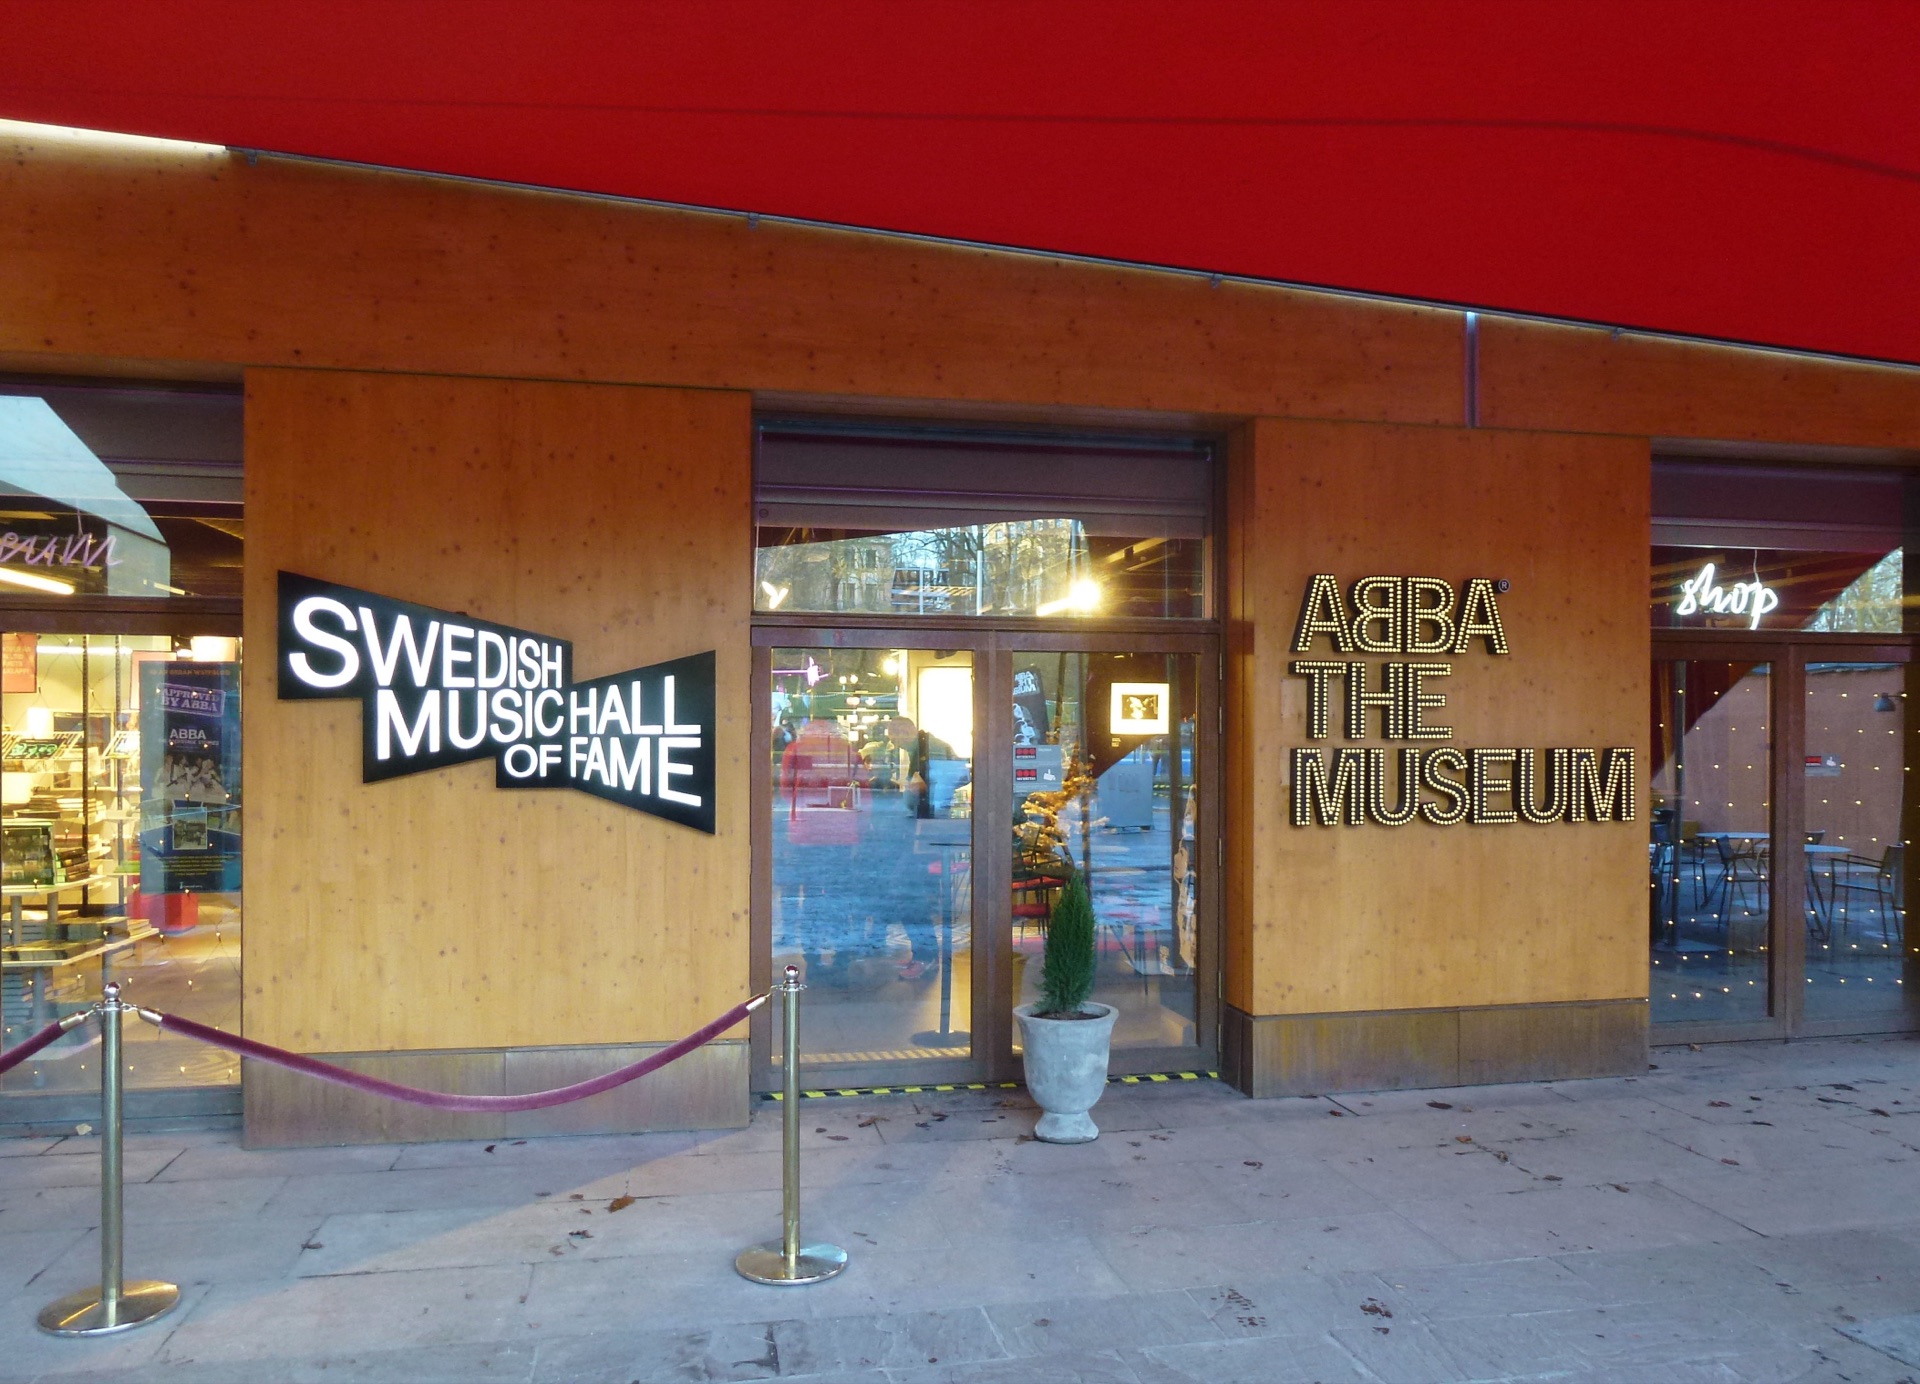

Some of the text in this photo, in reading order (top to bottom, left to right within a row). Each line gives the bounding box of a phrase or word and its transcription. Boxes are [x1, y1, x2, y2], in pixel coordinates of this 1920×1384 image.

[1295, 573, 1510, 655] ABBA
[1676, 562, 1779, 631] shop
[288, 595, 563, 690] SWEDISH
[169, 728, 207, 740] ABBA
[181, 699, 218, 712] ABBA
[376, 674, 702, 761] MUSIC HALL
[1293, 660, 1454, 740] THE
[503, 736, 702, 807] OF FAME
[1294, 746, 1636, 827] MUSEUM
